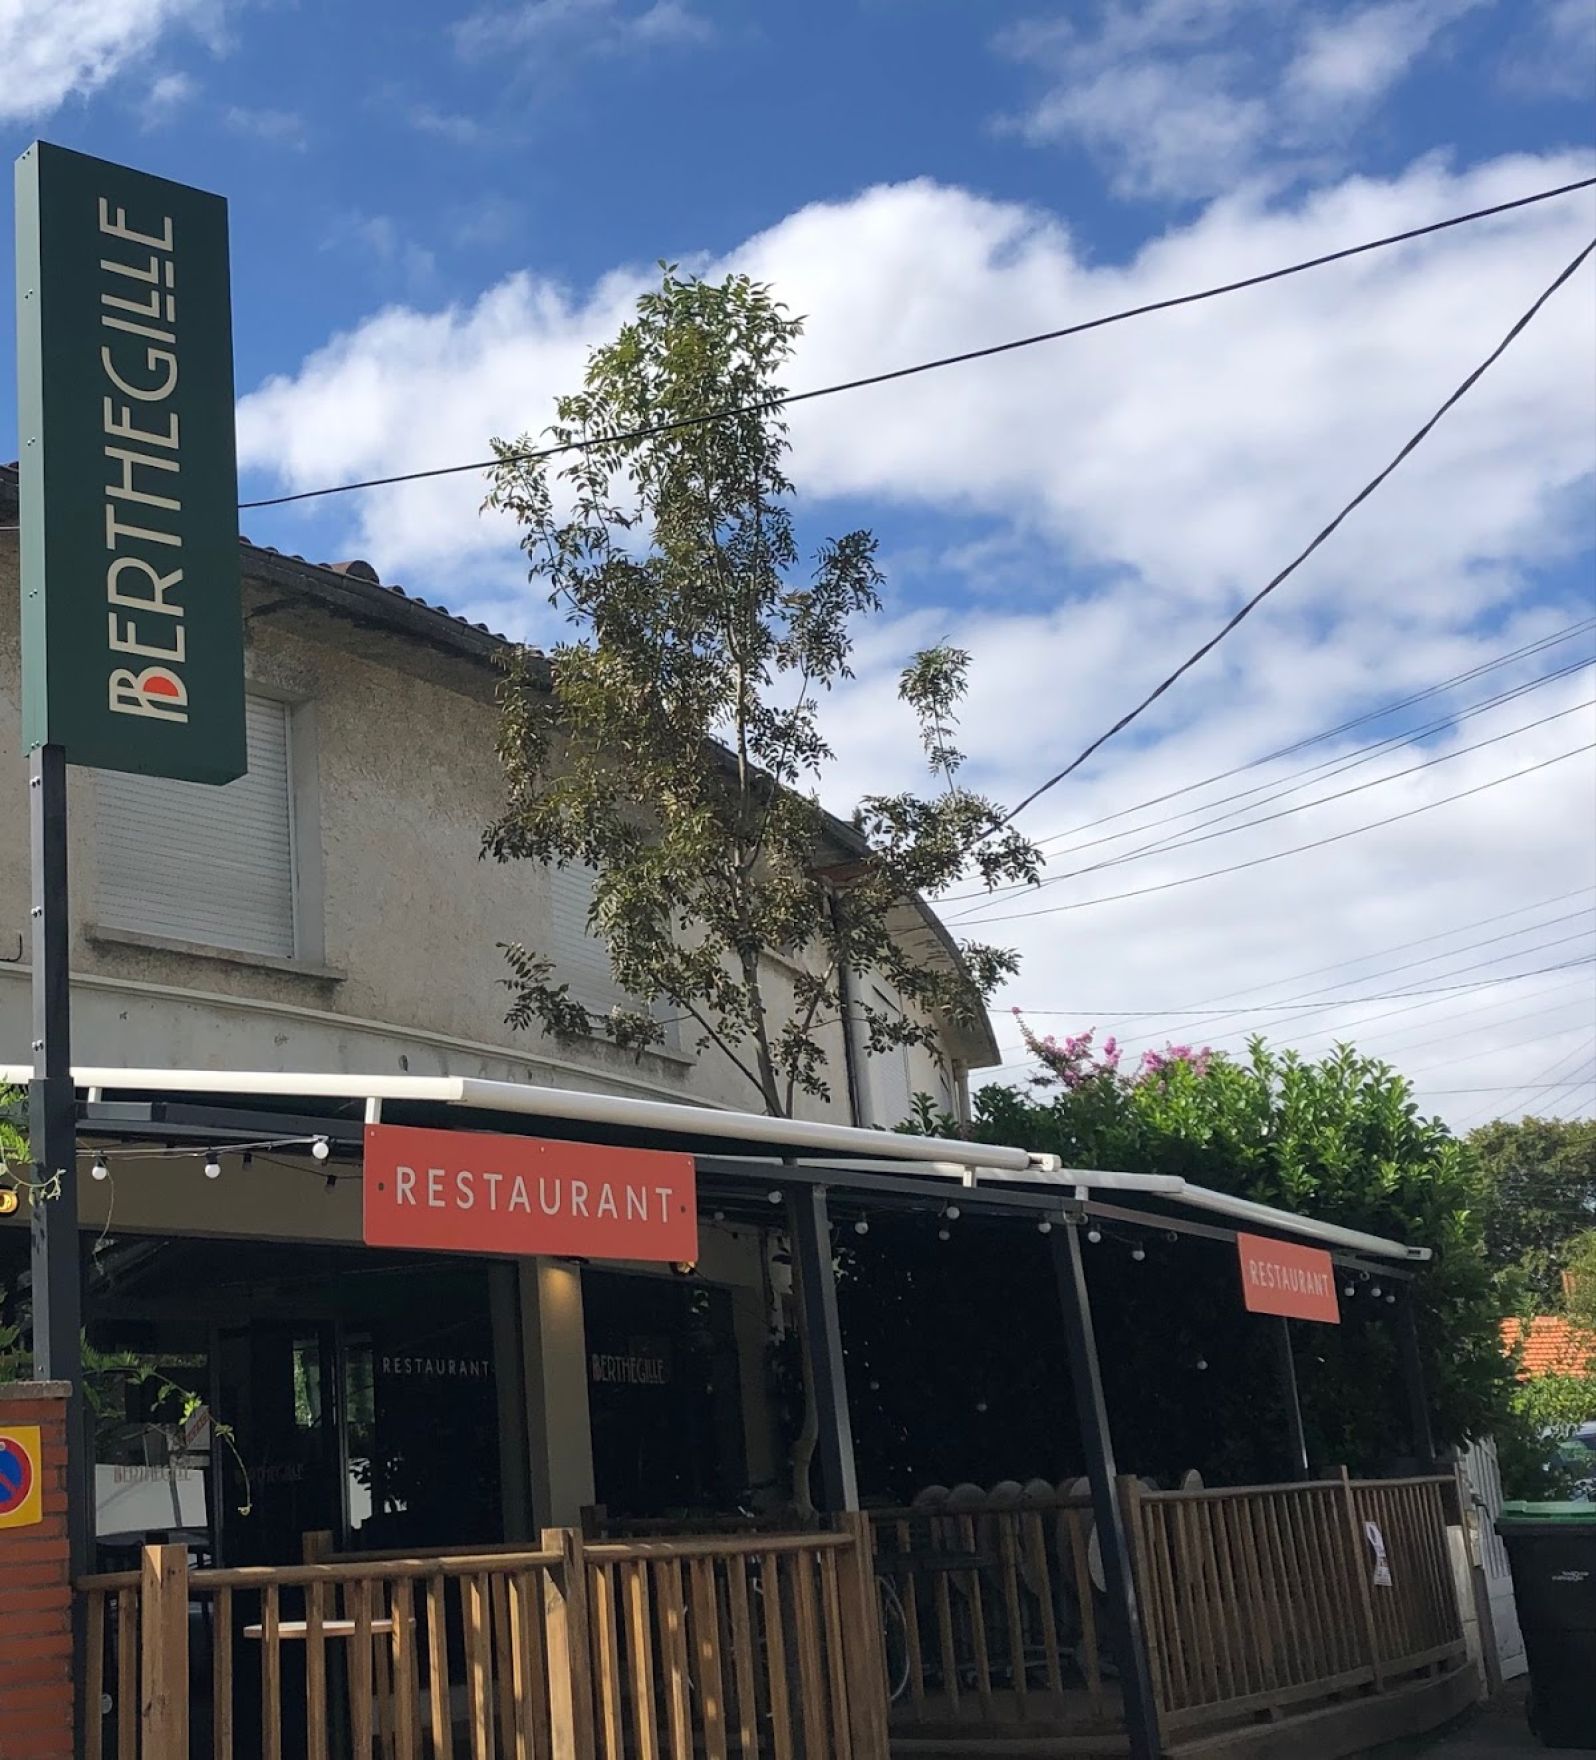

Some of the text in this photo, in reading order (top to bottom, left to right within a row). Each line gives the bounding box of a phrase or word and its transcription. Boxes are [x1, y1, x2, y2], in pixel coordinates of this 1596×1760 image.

[99, 197, 188, 723] BERTHEGILLE
[396, 1166, 672, 1223] RESTAURANT
[1249, 1260, 1328, 1297] RESTAURANT
[382, 1356, 489, 1376] RESTAURANT
[591, 1353, 666, 1385] BERTHEGILLE
